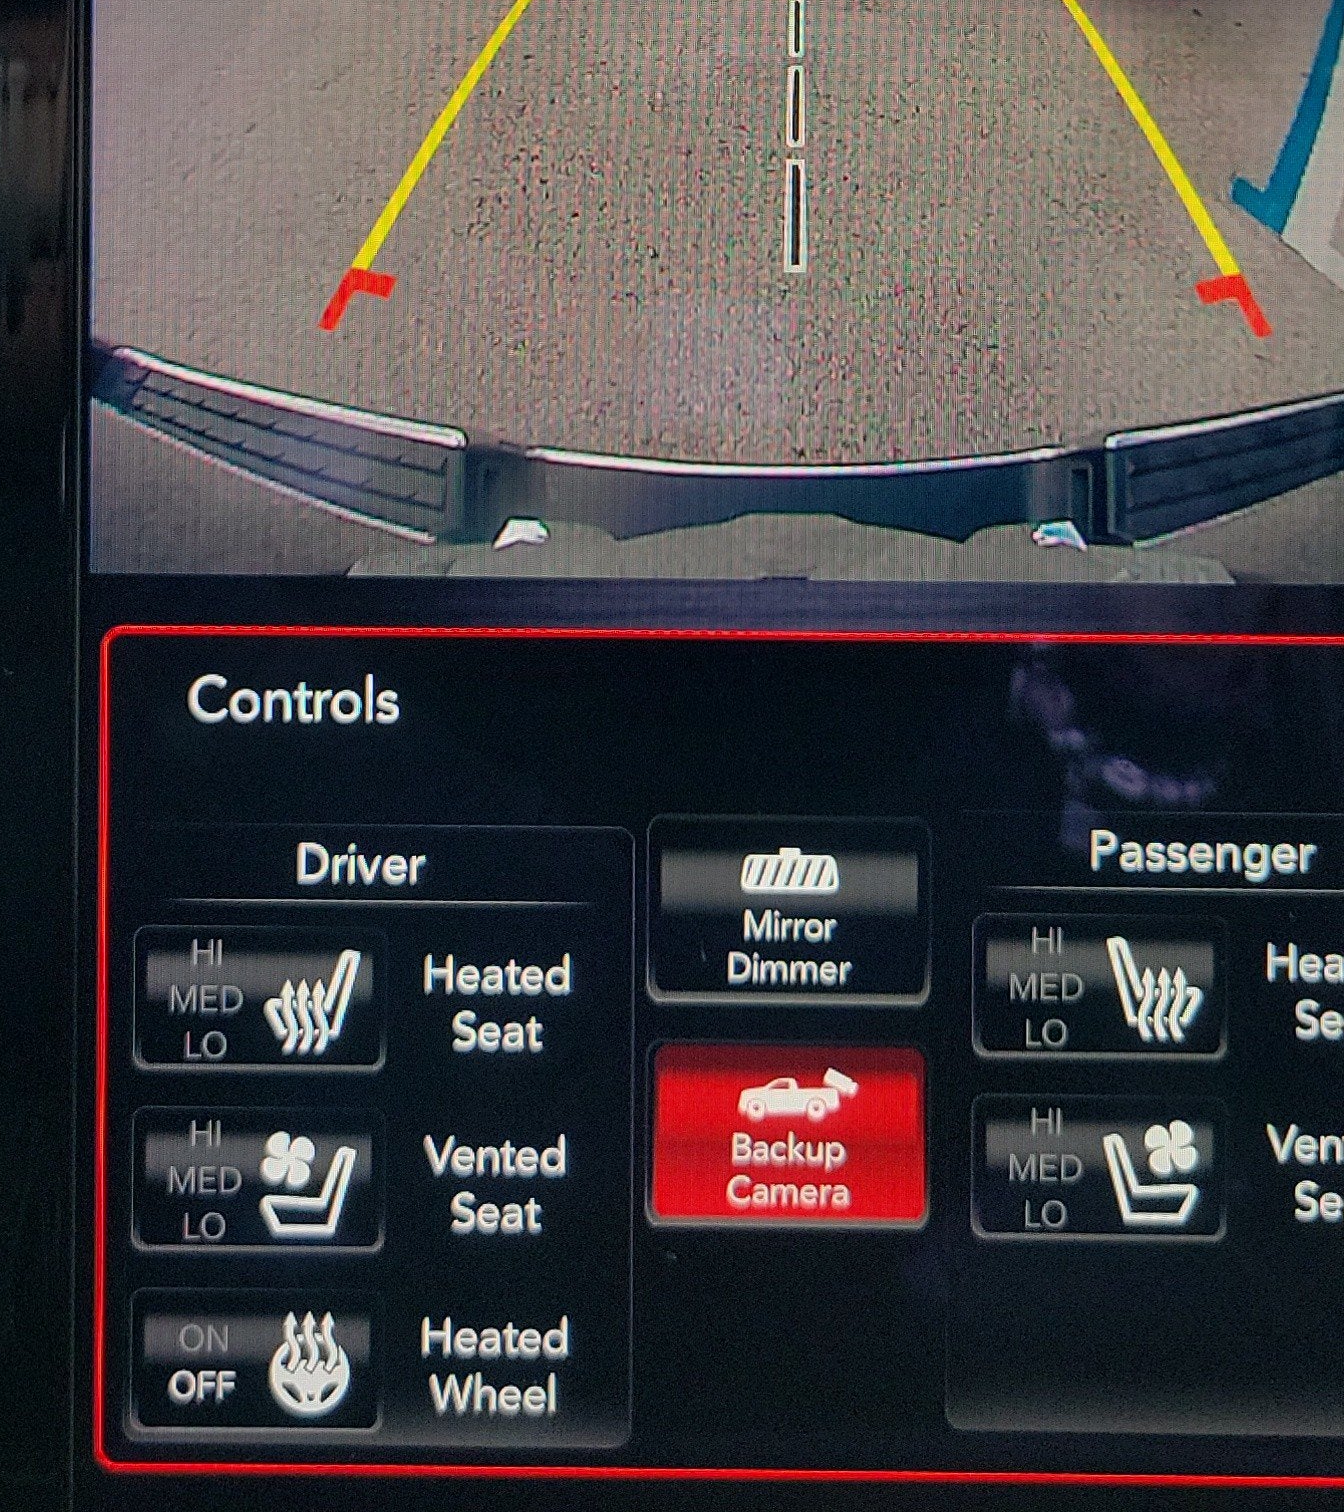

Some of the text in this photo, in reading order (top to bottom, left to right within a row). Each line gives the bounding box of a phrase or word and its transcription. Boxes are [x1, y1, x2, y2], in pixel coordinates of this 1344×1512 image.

[187, 674, 400, 724] Controls
[296, 842, 426, 886] Driver
[1090, 828, 1318, 882] Passenger
[742, 909, 837, 944] Mirror
[1031, 926, 1063, 956] HI
[191, 938, 224, 967] HI
[727, 951, 852, 986] Dimmer
[423, 953, 573, 994] Heated
[1009, 973, 1084, 1003] MED
[169, 984, 244, 1015] MED
[185, 1031, 227, 1060] LO
[452, 1009, 544, 1052] Seat
[1026, 1019, 1068, 1049] LO
[189, 1120, 222, 1148] HI
[1031, 1107, 1062, 1136] HI
[423, 1134, 567, 1178] Vented
[731, 1131, 848, 1175] Backup
[1009, 1153, 1083, 1183] MED
[167, 1165, 243, 1195] MED
[726, 1174, 852, 1210] Camera
[183, 1212, 227, 1243] LO
[451, 1191, 543, 1236] Seat
[1025, 1200, 1068, 1230] LO
[178, 1324, 230, 1352] ON
[421, 1316, 570, 1361] Heated
[167, 1368, 236, 1404] OFF
[429, 1373, 558, 1416] Wheel
